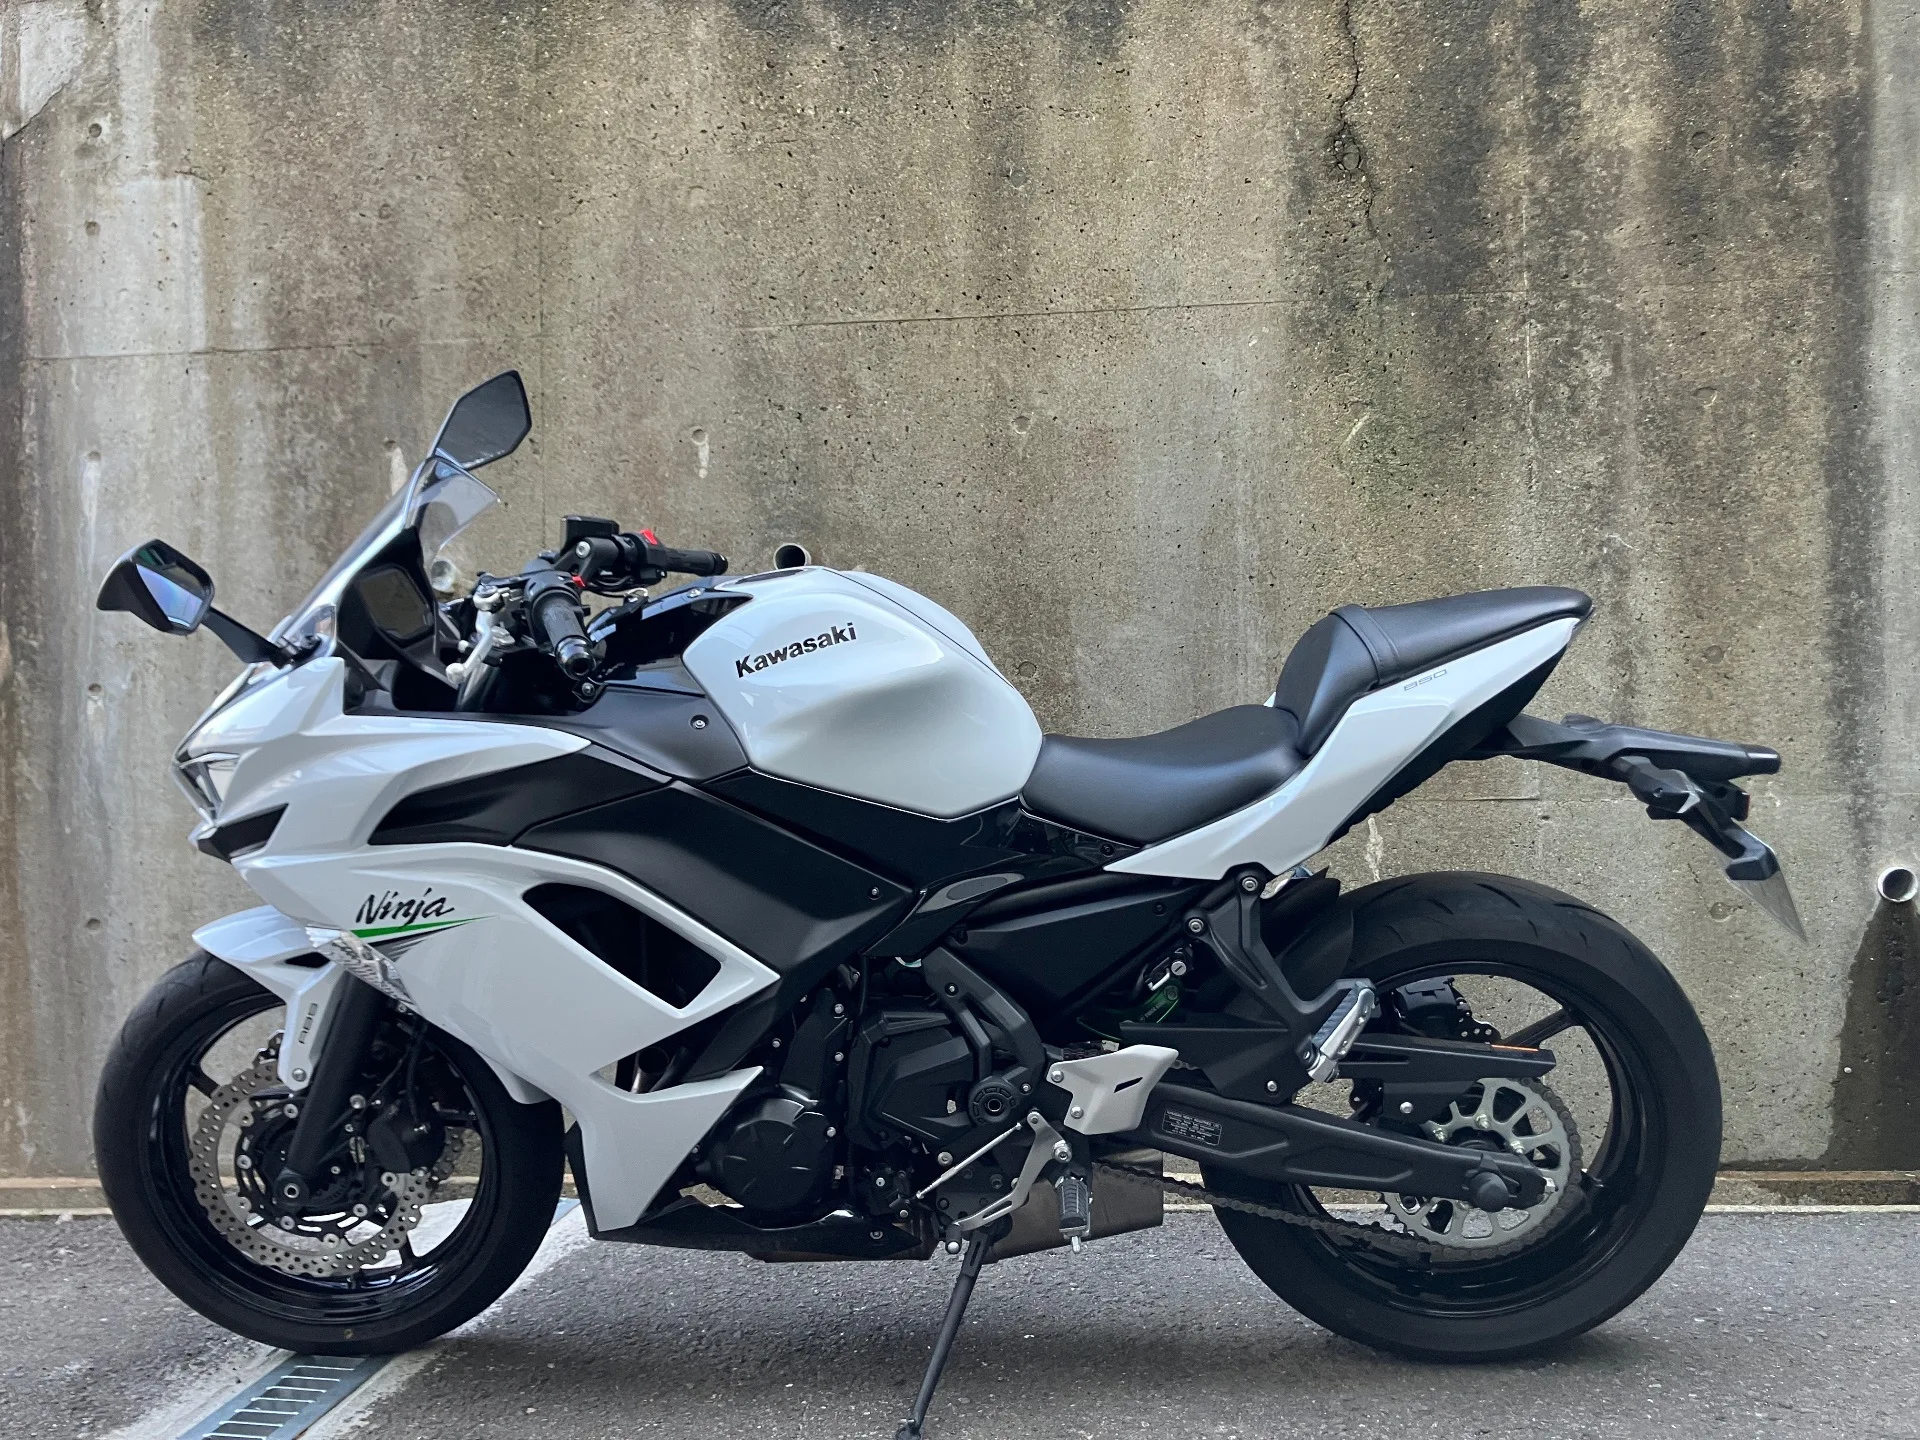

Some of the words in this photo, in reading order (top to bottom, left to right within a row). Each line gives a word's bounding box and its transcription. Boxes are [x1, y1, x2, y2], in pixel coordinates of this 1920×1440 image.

[735, 622, 857, 678] Kawasaki
[1403, 668, 1448, 692] 650
[355, 887, 455, 929] Ninja
[298, 1003, 318, 1045] ABS
